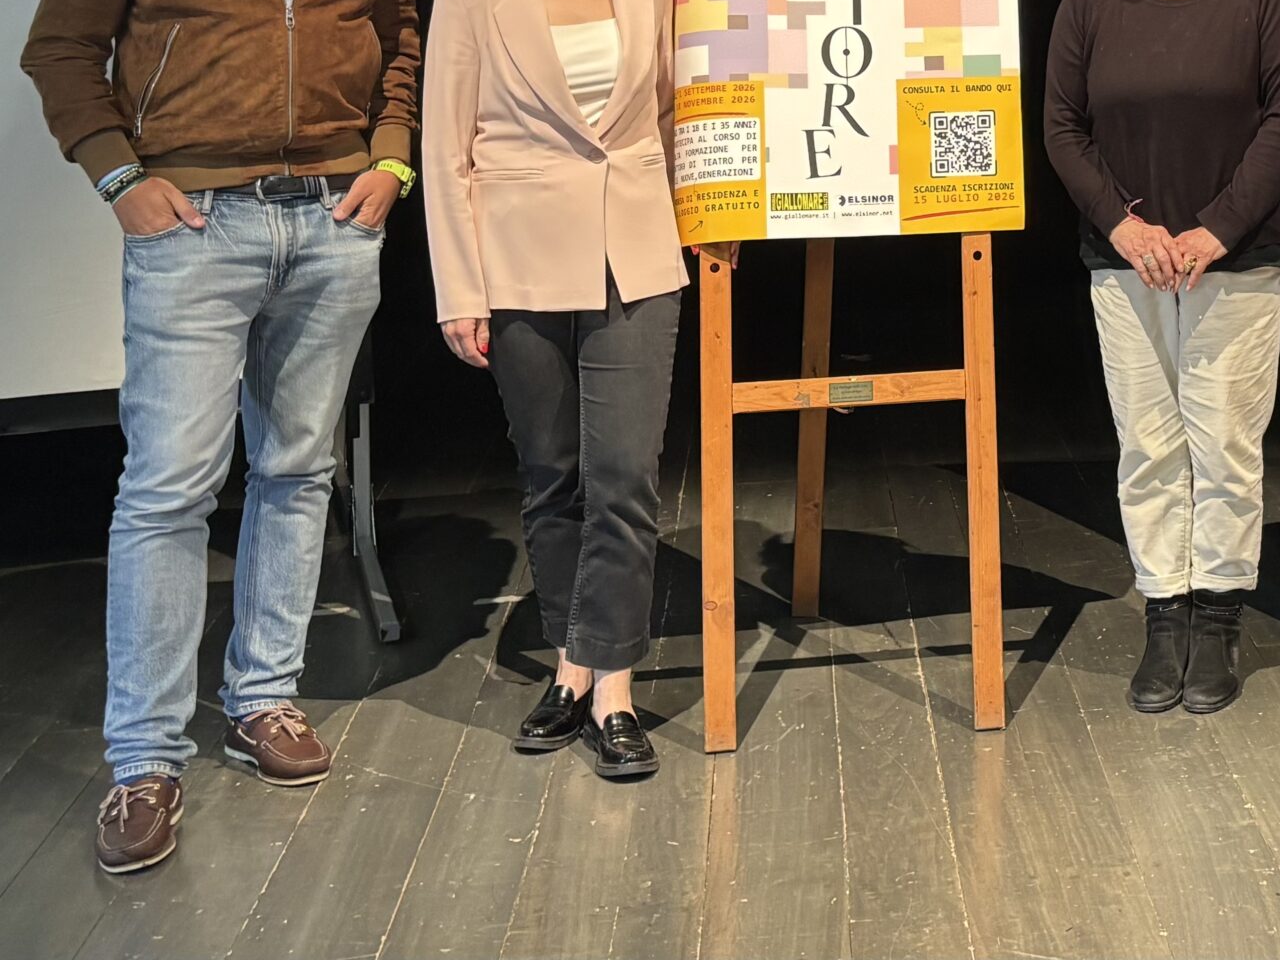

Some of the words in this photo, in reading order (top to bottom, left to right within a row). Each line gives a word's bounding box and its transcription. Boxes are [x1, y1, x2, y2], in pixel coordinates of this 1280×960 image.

[684, 85, 727, 96] SETTEMBRE
[903, 86, 945, 94] CONSULTA
[997, 84, 1012, 93] QUI
[684, 97, 724, 108] NOVEMBRE
[714, 133, 740, 141] CORSO
[686, 145, 728, 157] FORMAZIONE
[703, 157, 733, 166] TEATRO
[698, 168, 753, 179] GENERAZIONI
[914, 185, 956, 193] SCADENZA
[963, 183, 1014, 191] ISCRIZIONI
[697, 190, 747, 201] RESIDENZA
[848, 195, 894, 203] ELSINOR
[914, 196, 927, 204] 15
[937, 194, 979, 203] LUGLIO
[988, 193, 1015, 201] 2026
[705, 202, 759, 212] GRATUITO
[776, 193, 824, 210] GIALLOMARE
